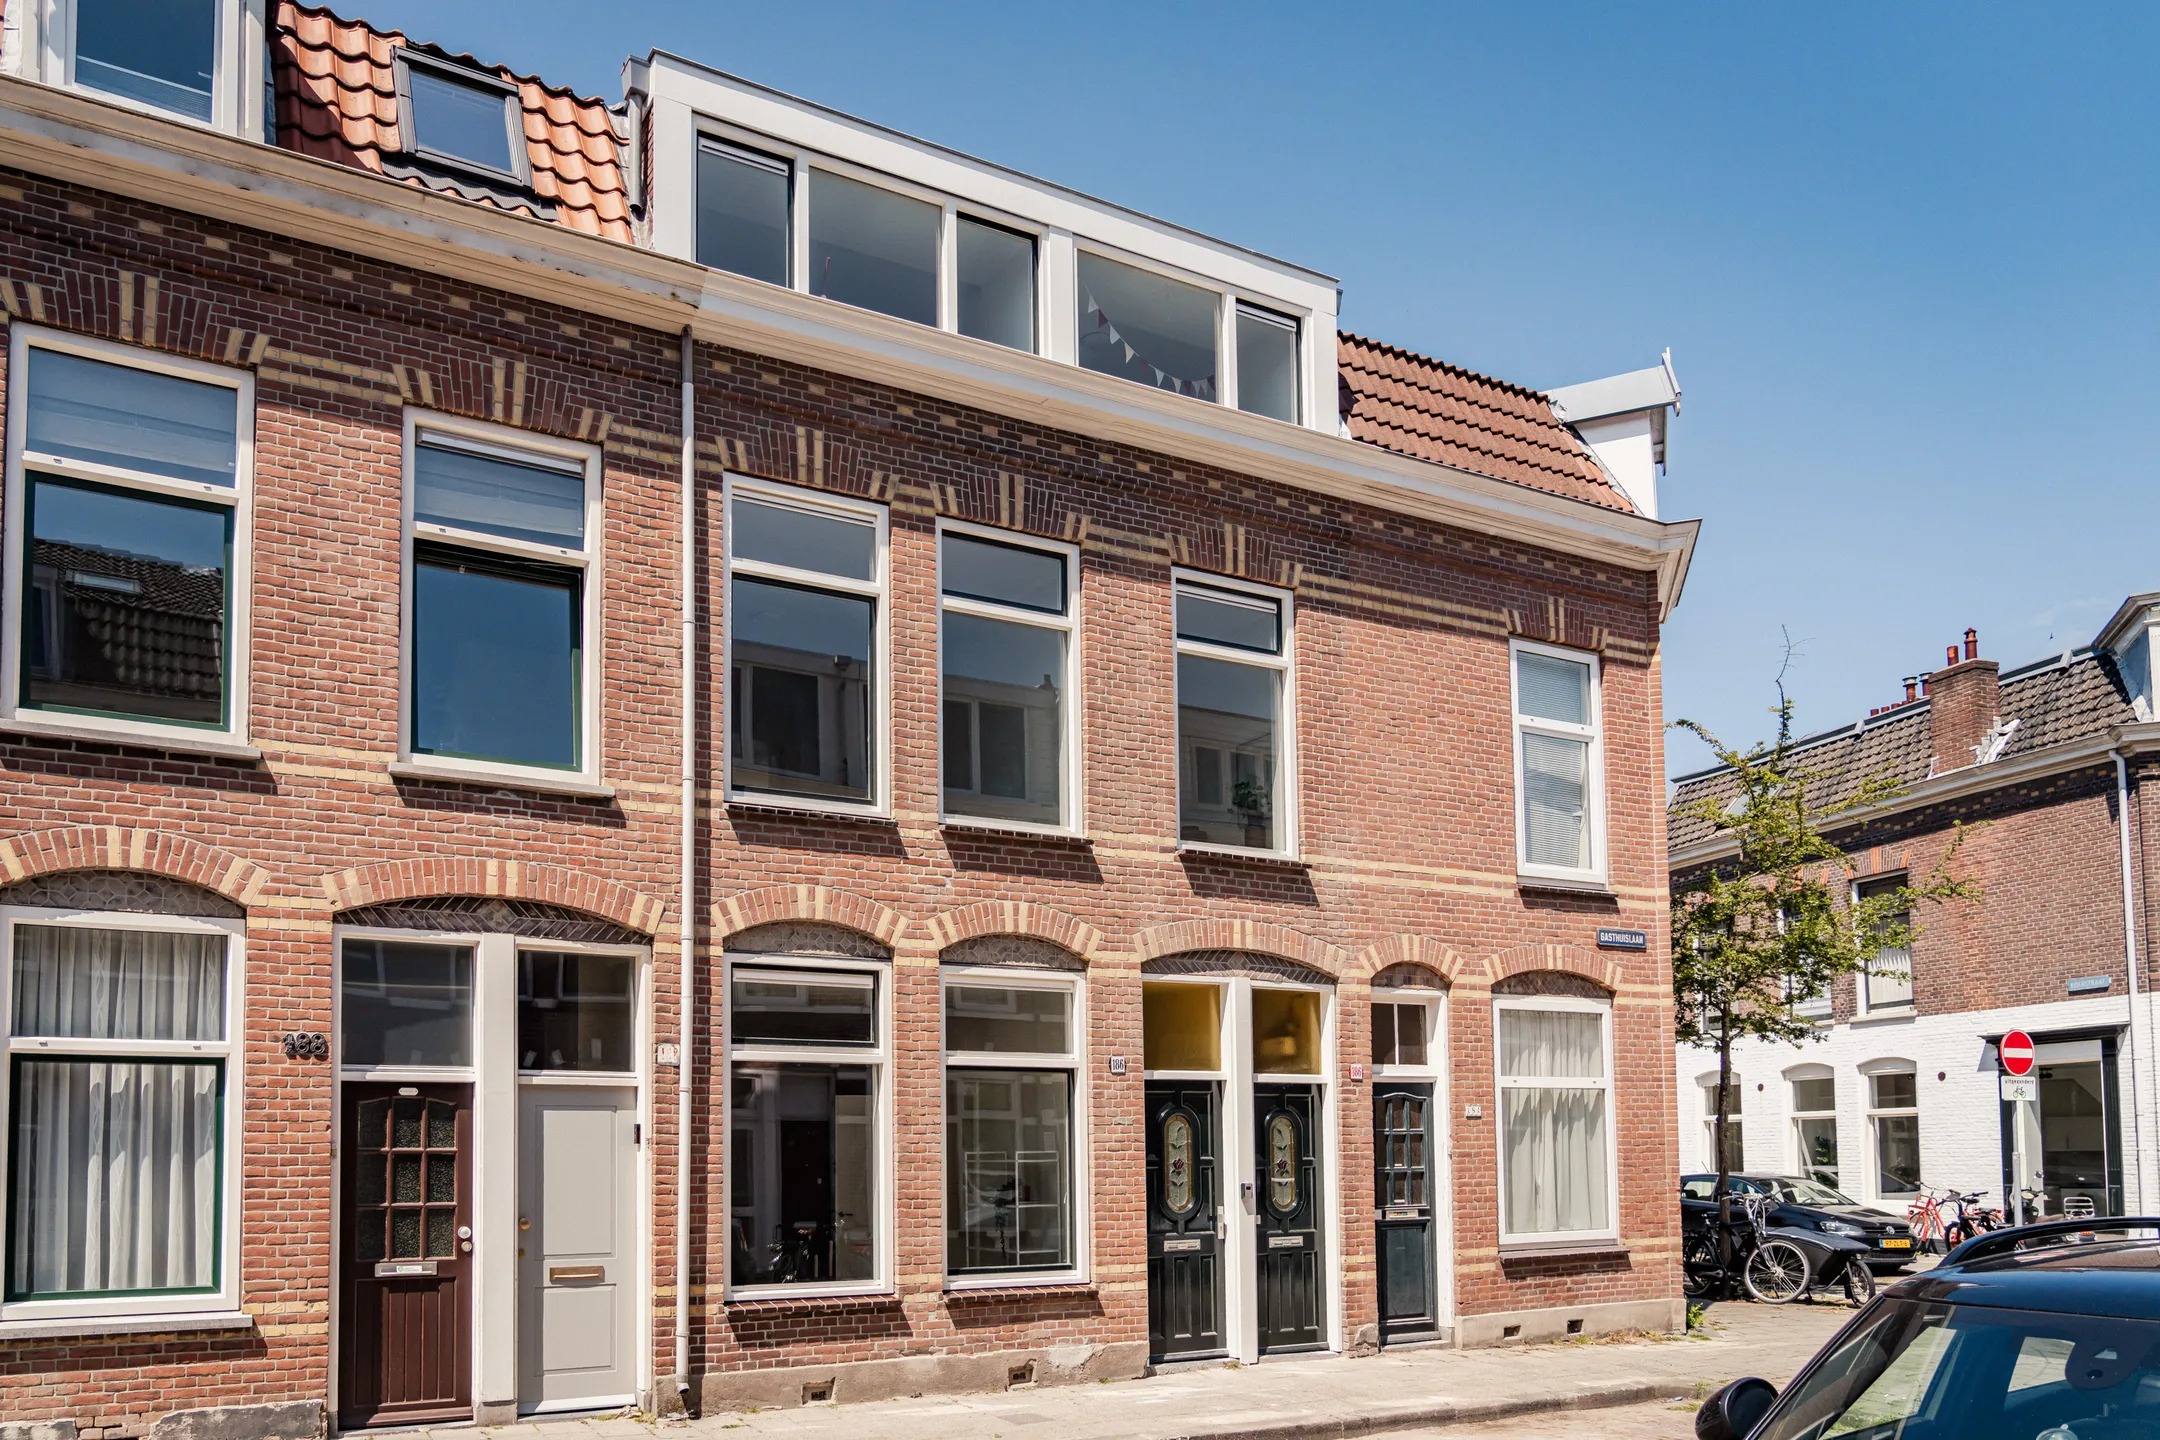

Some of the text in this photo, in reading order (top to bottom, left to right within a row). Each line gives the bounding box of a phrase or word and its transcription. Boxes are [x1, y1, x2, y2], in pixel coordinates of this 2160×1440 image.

[1600, 932, 1644, 944] GASTHUISLAAN
[283, 1032, 326, 1055] 188
[1112, 1058, 1124, 1071] 186
[1351, 1066, 1362, 1077] 186
